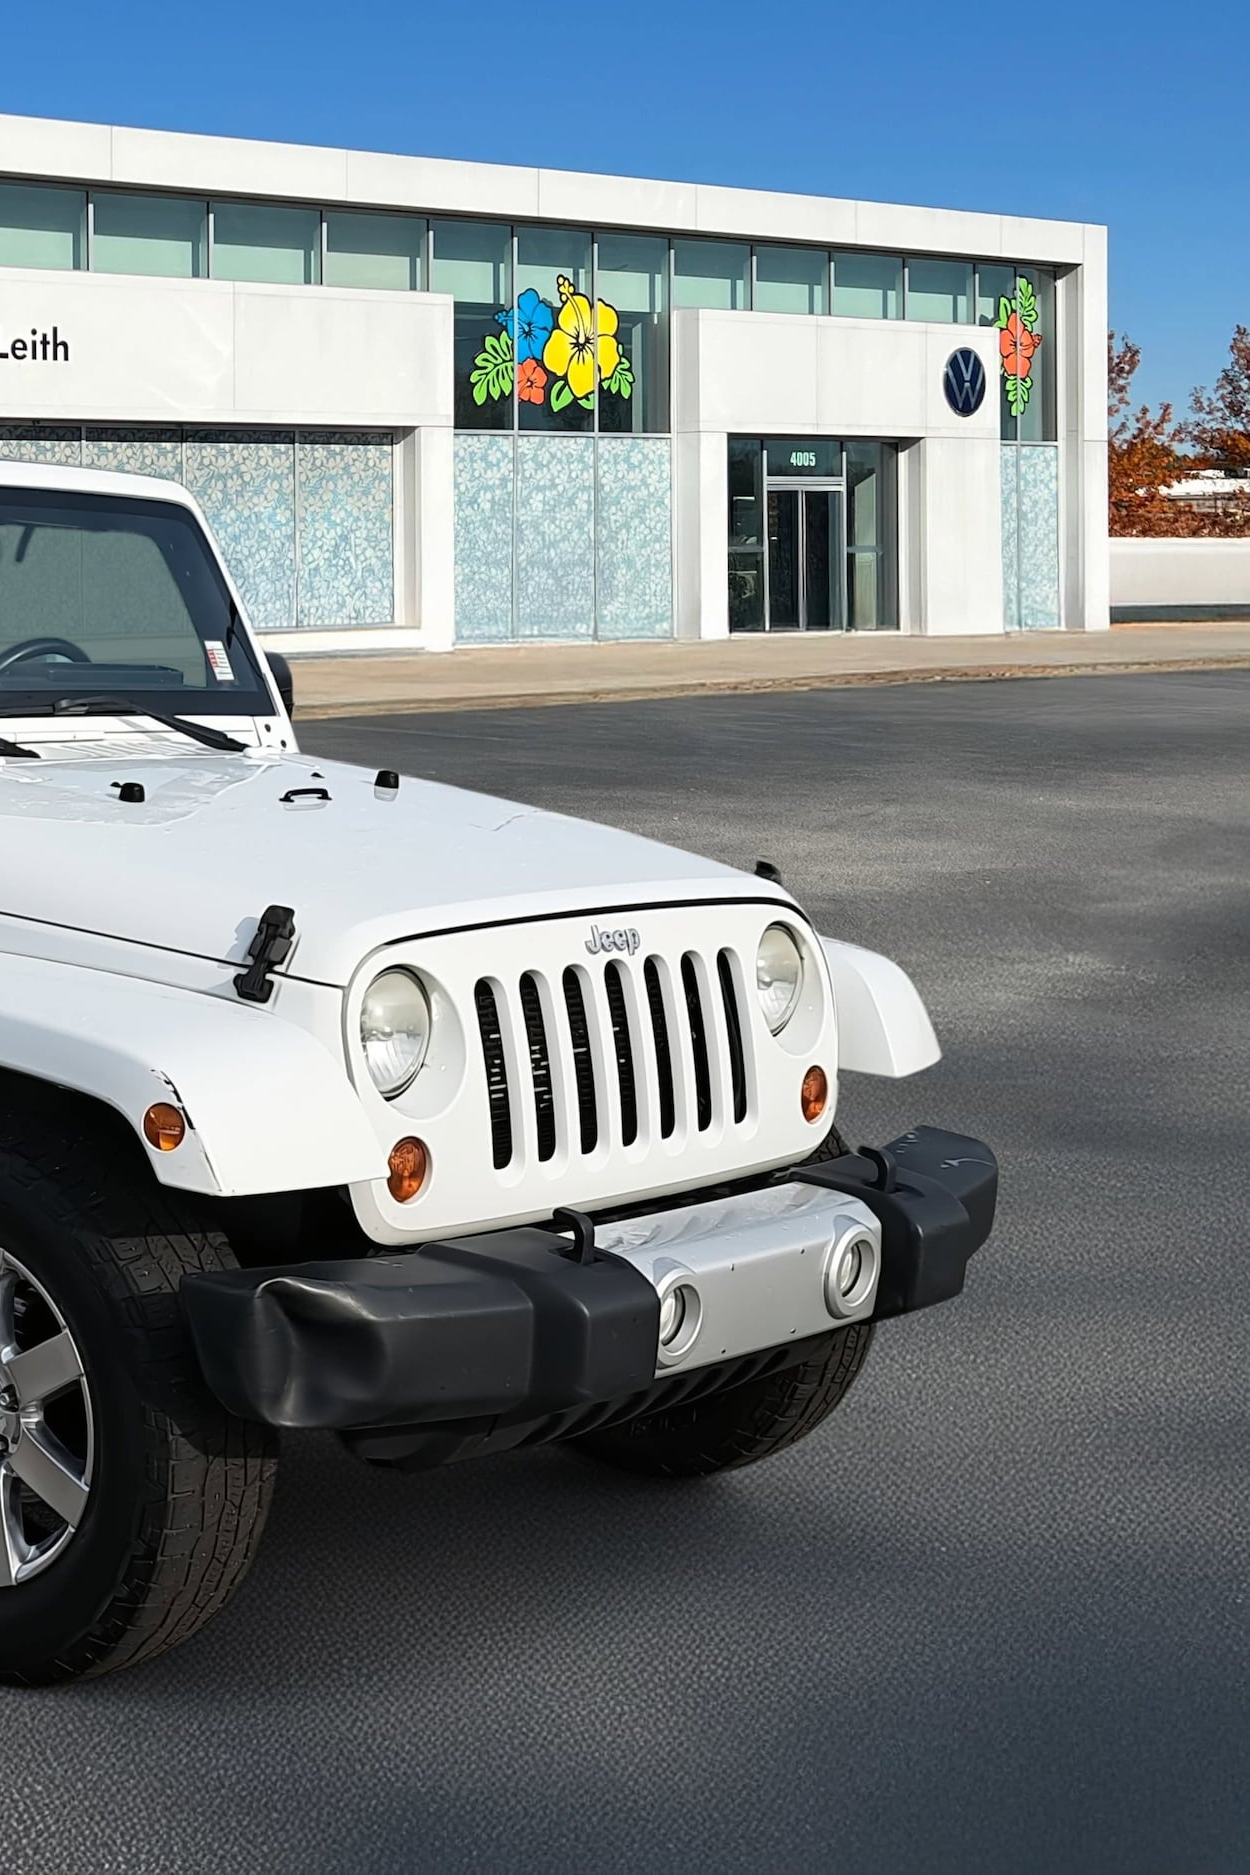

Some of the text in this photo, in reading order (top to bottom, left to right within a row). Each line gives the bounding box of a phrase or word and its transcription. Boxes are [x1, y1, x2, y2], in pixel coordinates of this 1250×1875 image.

[946, 349, 984, 411] VW
[790, 452, 816, 467] 4005
[584, 924, 641, 956] Jeep
